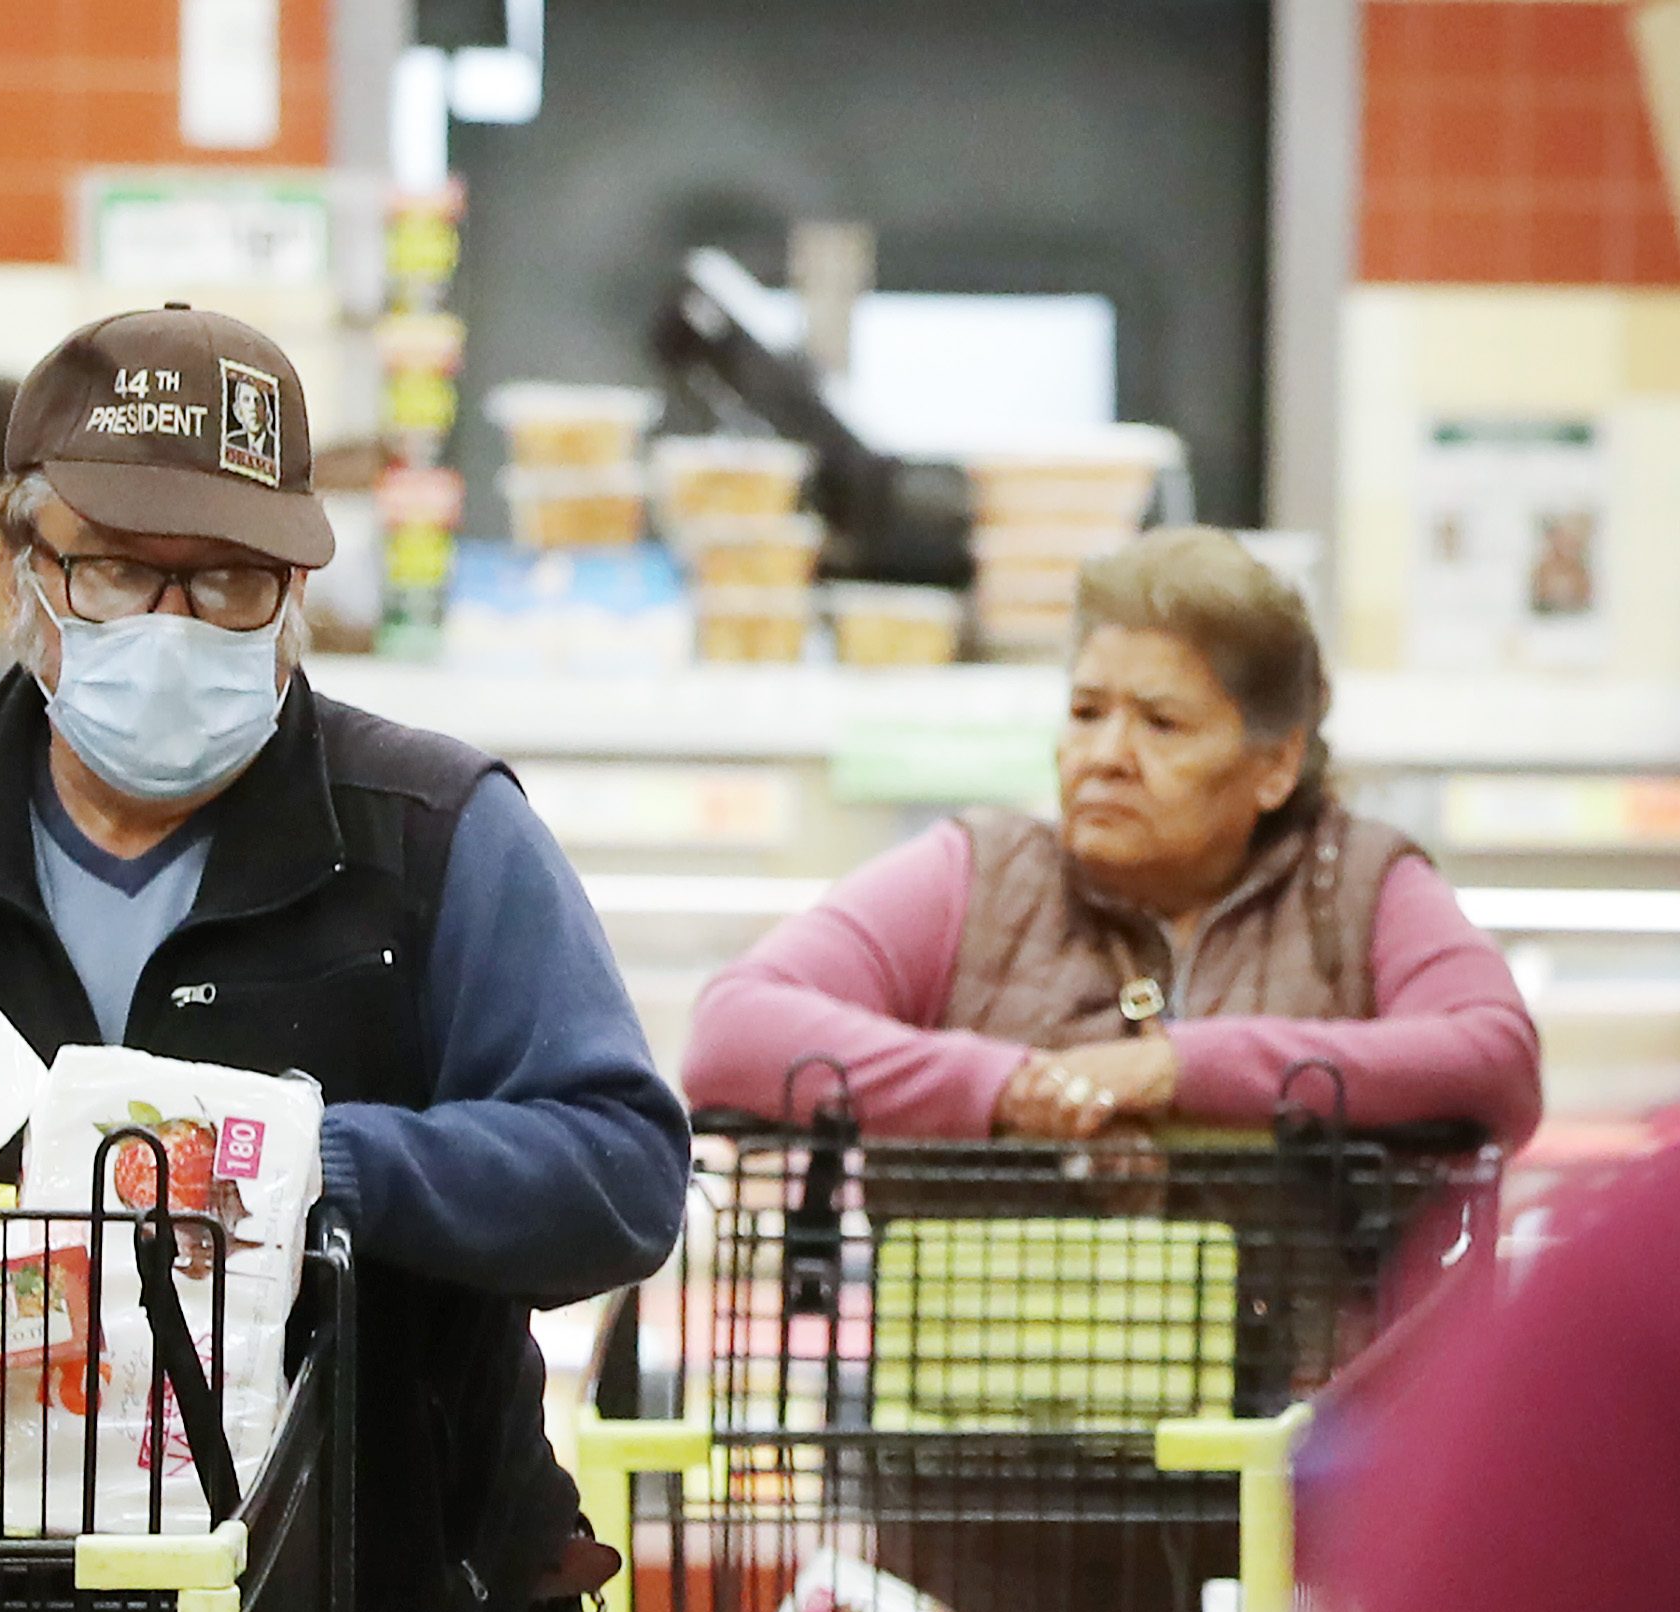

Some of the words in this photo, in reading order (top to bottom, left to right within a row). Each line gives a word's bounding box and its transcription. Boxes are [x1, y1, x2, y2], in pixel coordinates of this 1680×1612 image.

[114, 368, 151, 399] 44
[155, 370, 181, 392] TH
[85, 402, 208, 438] PRESIDENT
[225, 1121, 257, 1171] 180
